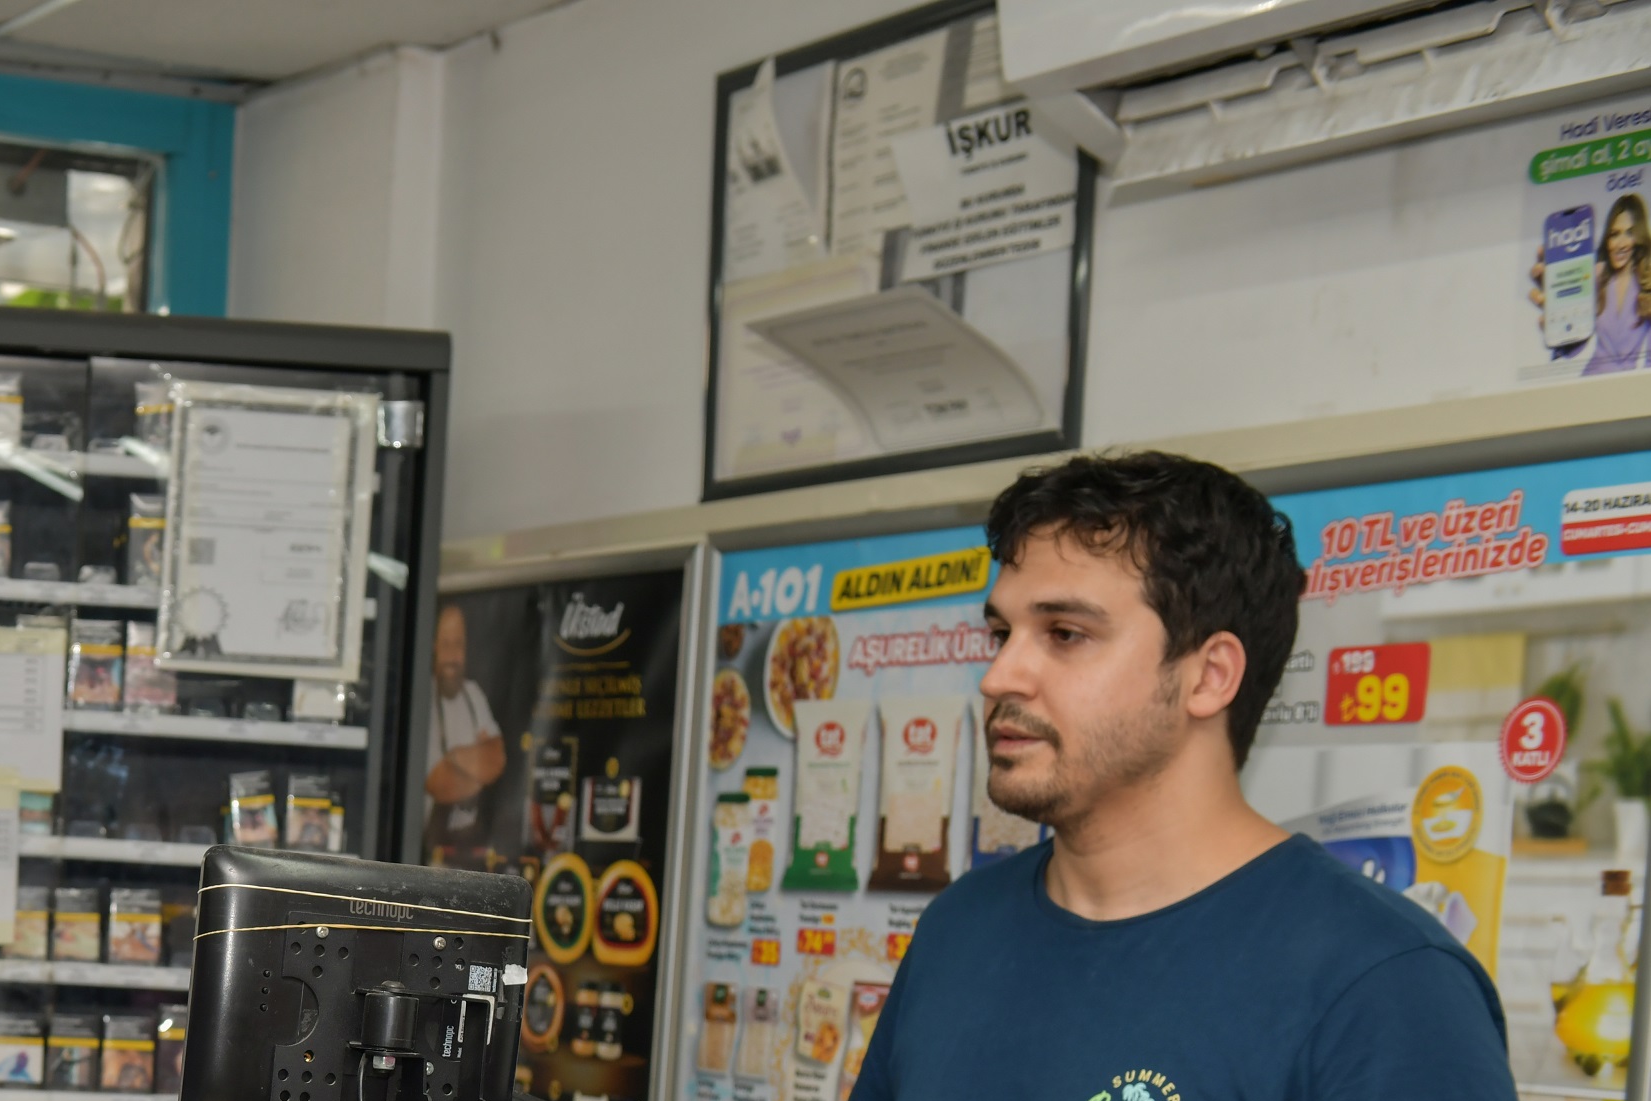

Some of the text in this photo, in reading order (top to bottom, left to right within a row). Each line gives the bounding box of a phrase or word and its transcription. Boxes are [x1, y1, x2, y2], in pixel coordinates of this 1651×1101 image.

[1618, 139, 1630, 161] 2
[1549, 219, 1590, 248] hadi
[1323, 492, 1524, 556] 10 TL ve üzeri
[837, 553, 983, 602] ALDIN ALDIN!
[1304, 527, 1547, 603] lışverişlerinizde
[1519, 711, 1546, 751] 3
[1513, 750, 1550, 768] KATLI
[442, 1025, 455, 1058] technopc
